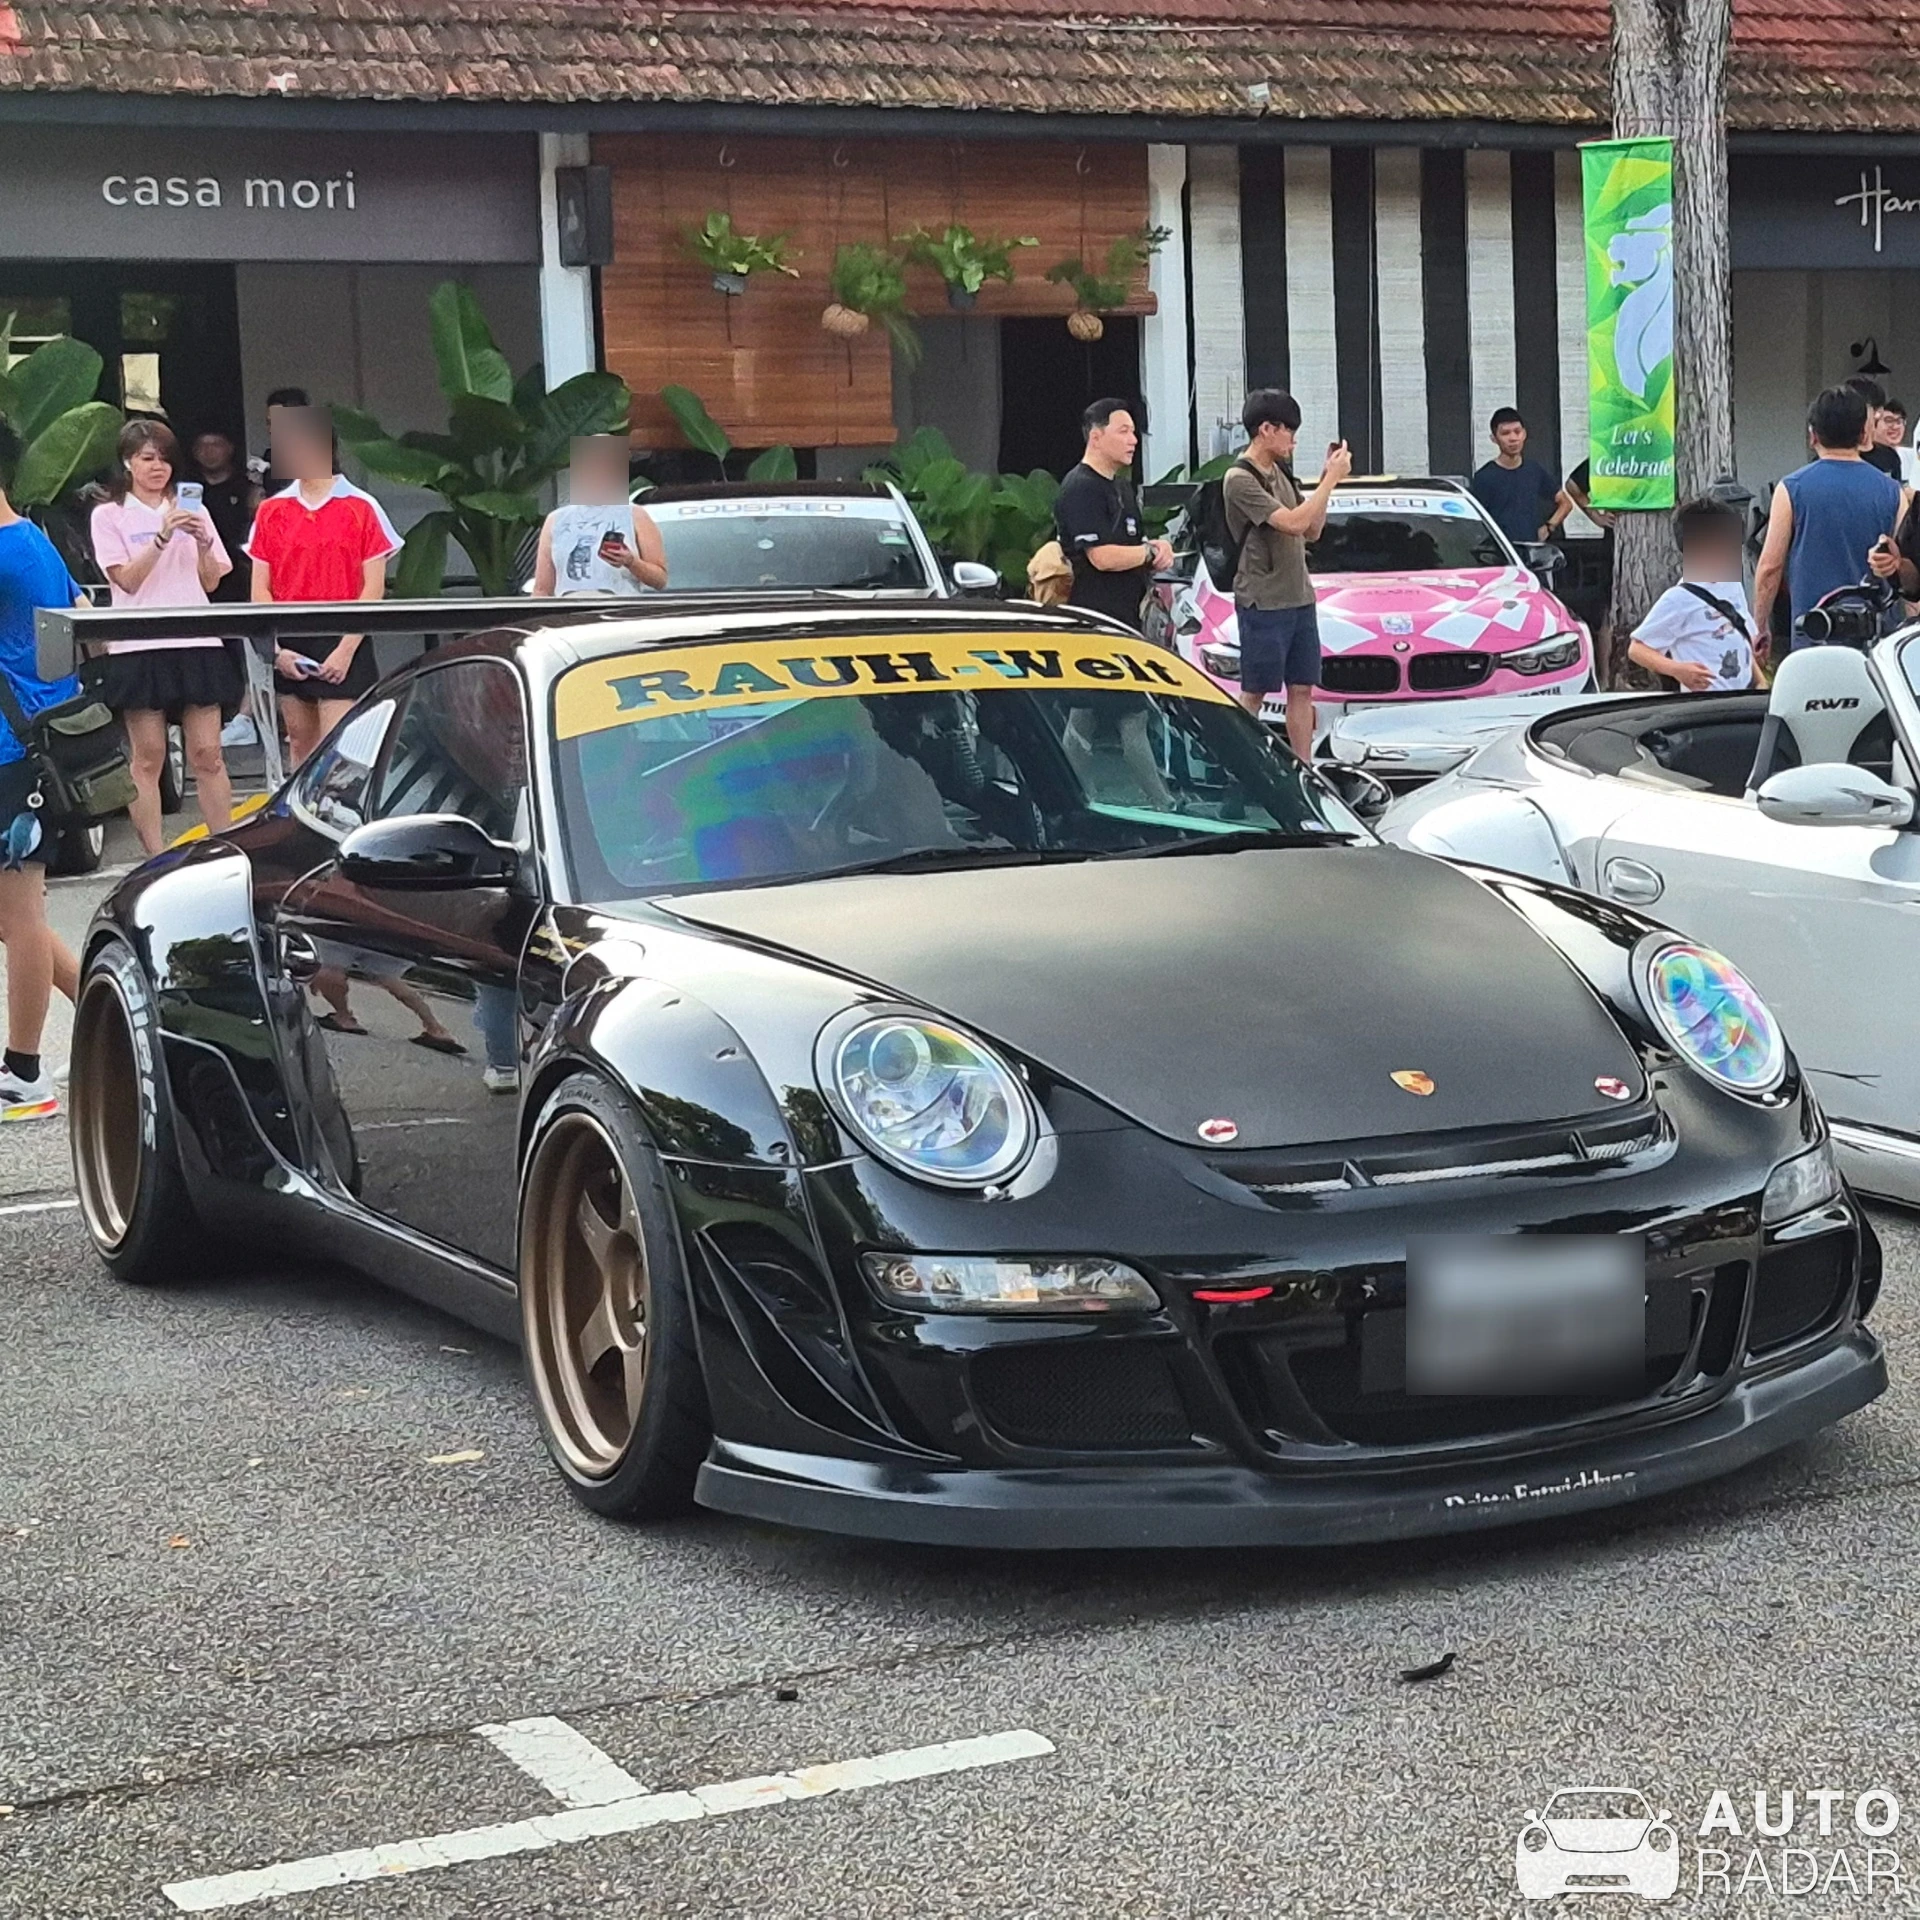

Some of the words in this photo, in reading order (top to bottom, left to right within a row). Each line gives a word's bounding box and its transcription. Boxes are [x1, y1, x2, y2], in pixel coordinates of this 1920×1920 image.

[102, 175, 222, 206] casa
[244, 170, 356, 209] mori
[1834, 165, 1920, 252] Han
[1610, 424, 1654, 446] Let's
[1595, 455, 1672, 477] Celebrate
[678, 502, 846, 516] GODSPEED
[1329, 497, 1428, 509] SPEED
[605, 649, 1184, 712] RAUH-Welt
[1517, 685, 1562, 698] OTUL
[1261, 701, 1287, 716] TUL
[1804, 697, 1861, 713] RWB
